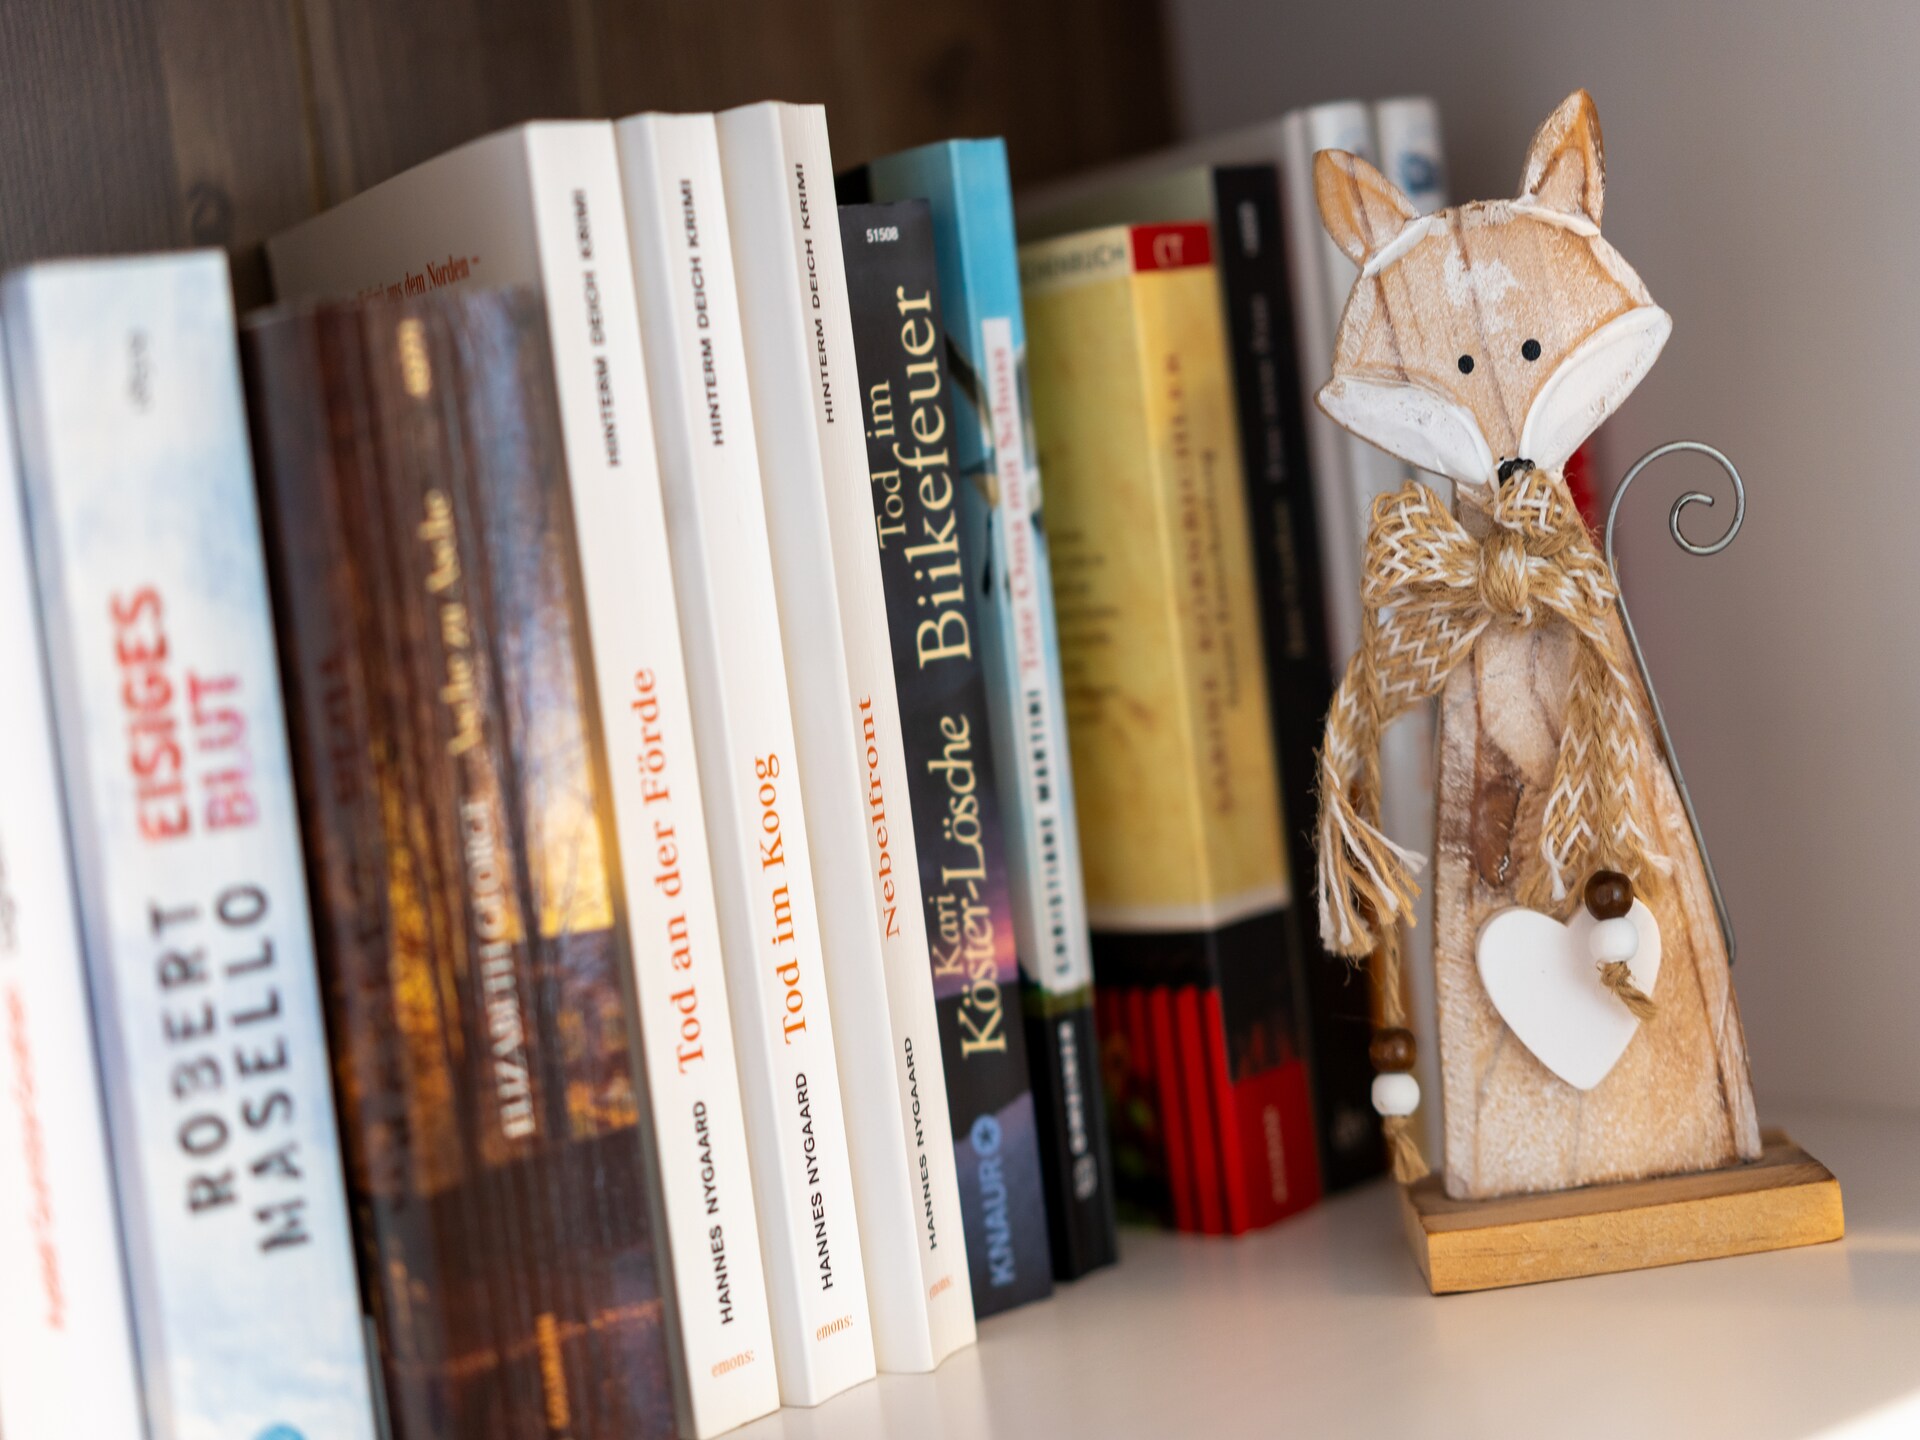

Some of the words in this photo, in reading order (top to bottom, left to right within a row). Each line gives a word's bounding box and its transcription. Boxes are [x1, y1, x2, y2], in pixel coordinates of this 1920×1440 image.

[572, 189, 594, 260] KRIMI
[680, 179, 699, 248] KRIMI
[796, 163, 810, 229] KRIMI
[866, 226, 899, 243] 51508
[404, 272, 426, 297] dem
[426, 254, 471, 290] Norden
[583, 270, 606, 345] DEICH
[689, 257, 709, 328] DEICH
[805, 239, 820, 309] DEICH
[594, 356, 621, 467] HINTERM
[699, 338, 724, 446] HINTERM
[813, 319, 834, 423] HINTERM
[866, 379, 895, 439] im
[872, 470, 906, 548] Tod
[897, 285, 972, 669] Biikefeuer
[1009, 513, 1036, 600] Oma
[110, 584, 191, 843] EISIGES
[188, 668, 258, 832] BLUT
[631, 668, 671, 808] Förde
[755, 753, 786, 872] Koog
[859, 694, 900, 942] Nebelfront
[654, 821, 683, 898] der
[927, 714, 1007, 1059] Köster-Lösche
[667, 913, 693, 971] an
[772, 882, 795, 945] im
[929, 896, 965, 979] Kari
[670, 986, 707, 1075] Tod
[775, 957, 807, 1045] Tod
[149, 896, 238, 1216] ROBERT
[215, 883, 312, 1256] MASELLO
[904, 1036, 924, 1147] NYGAARD
[692, 1100, 723, 1215] NYGAARD
[795, 1072, 822, 1186] NYGAARD
[811, 1192, 834, 1291] HANNES
[918, 1154, 937, 1250] HANNES
[979, 1155, 1016, 1287] KNAUR
[709, 1224, 734, 1325] HANNES
[711, 1349, 756, 1378] emons:
[815, 1314, 854, 1341] emons:
